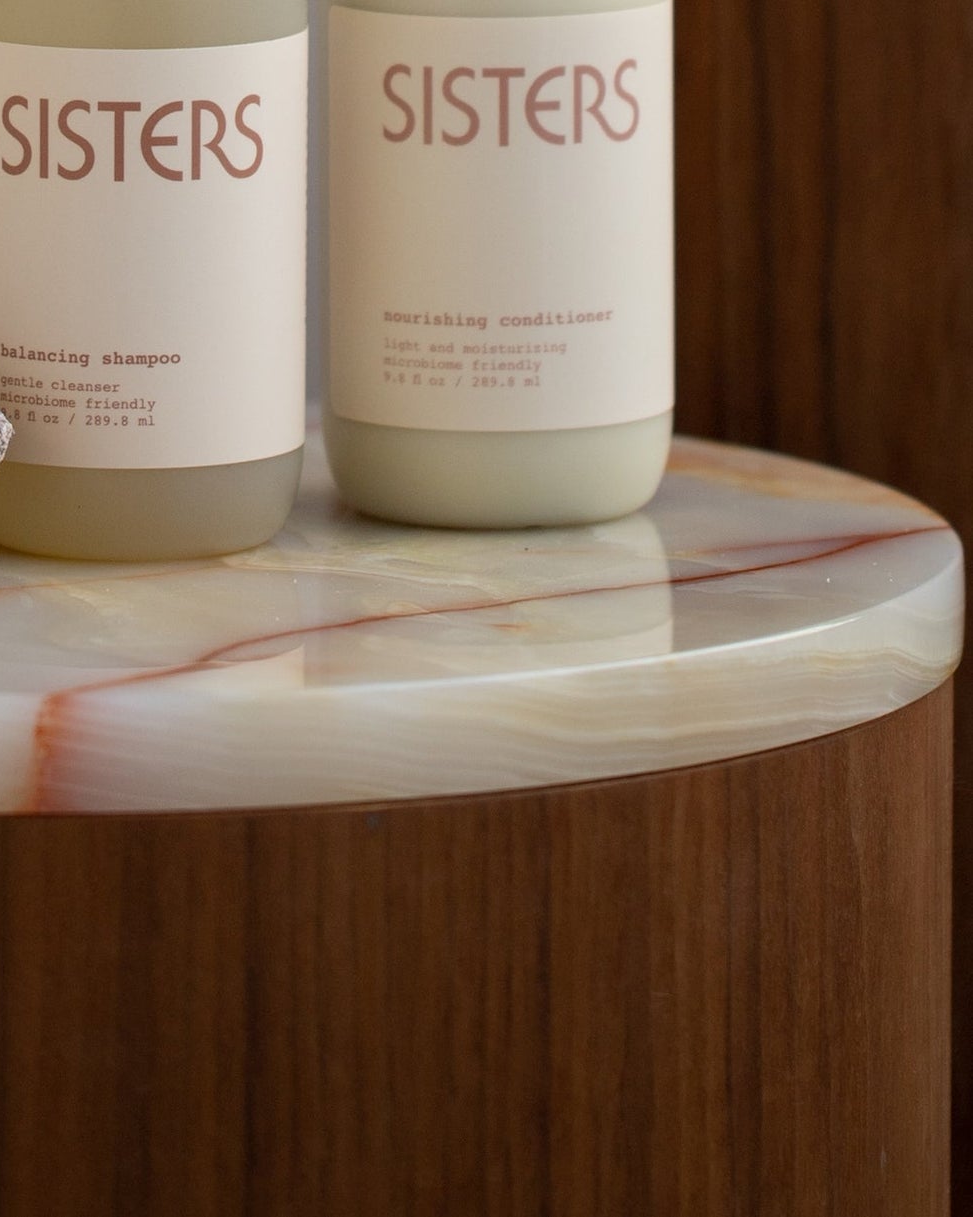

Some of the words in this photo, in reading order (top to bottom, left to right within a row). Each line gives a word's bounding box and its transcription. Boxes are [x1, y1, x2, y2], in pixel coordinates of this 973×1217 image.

[382, 58, 640, 147] SISTERS
[1, 94, 263, 182] SISTERS
[383, 310, 488, 330] nourishing
[499, 309, 614, 328] conditioner
[383, 336, 420, 353] light
[429, 342, 455, 354] and
[462, 340, 568, 355] moisturizing
[0, 343, 91, 368] balancing
[102, 351, 182, 369] shampoo
[383, 355, 464, 371] microbiome
[471, 359, 542, 372] friendly
[0, 375, 44, 389] gentle
[51, 380, 120, 393] cleanser
[429, 377, 446, 387] oz
[524, 375, 541, 387] ml
[0, 392, 76, 408] microbiome
[86, 398, 156, 412] friendly
[43, 414, 59, 424] oz
[68, 413, 76, 425] /
[85, 415, 129, 426] 289.8
[137, 415, 155, 426] ml
